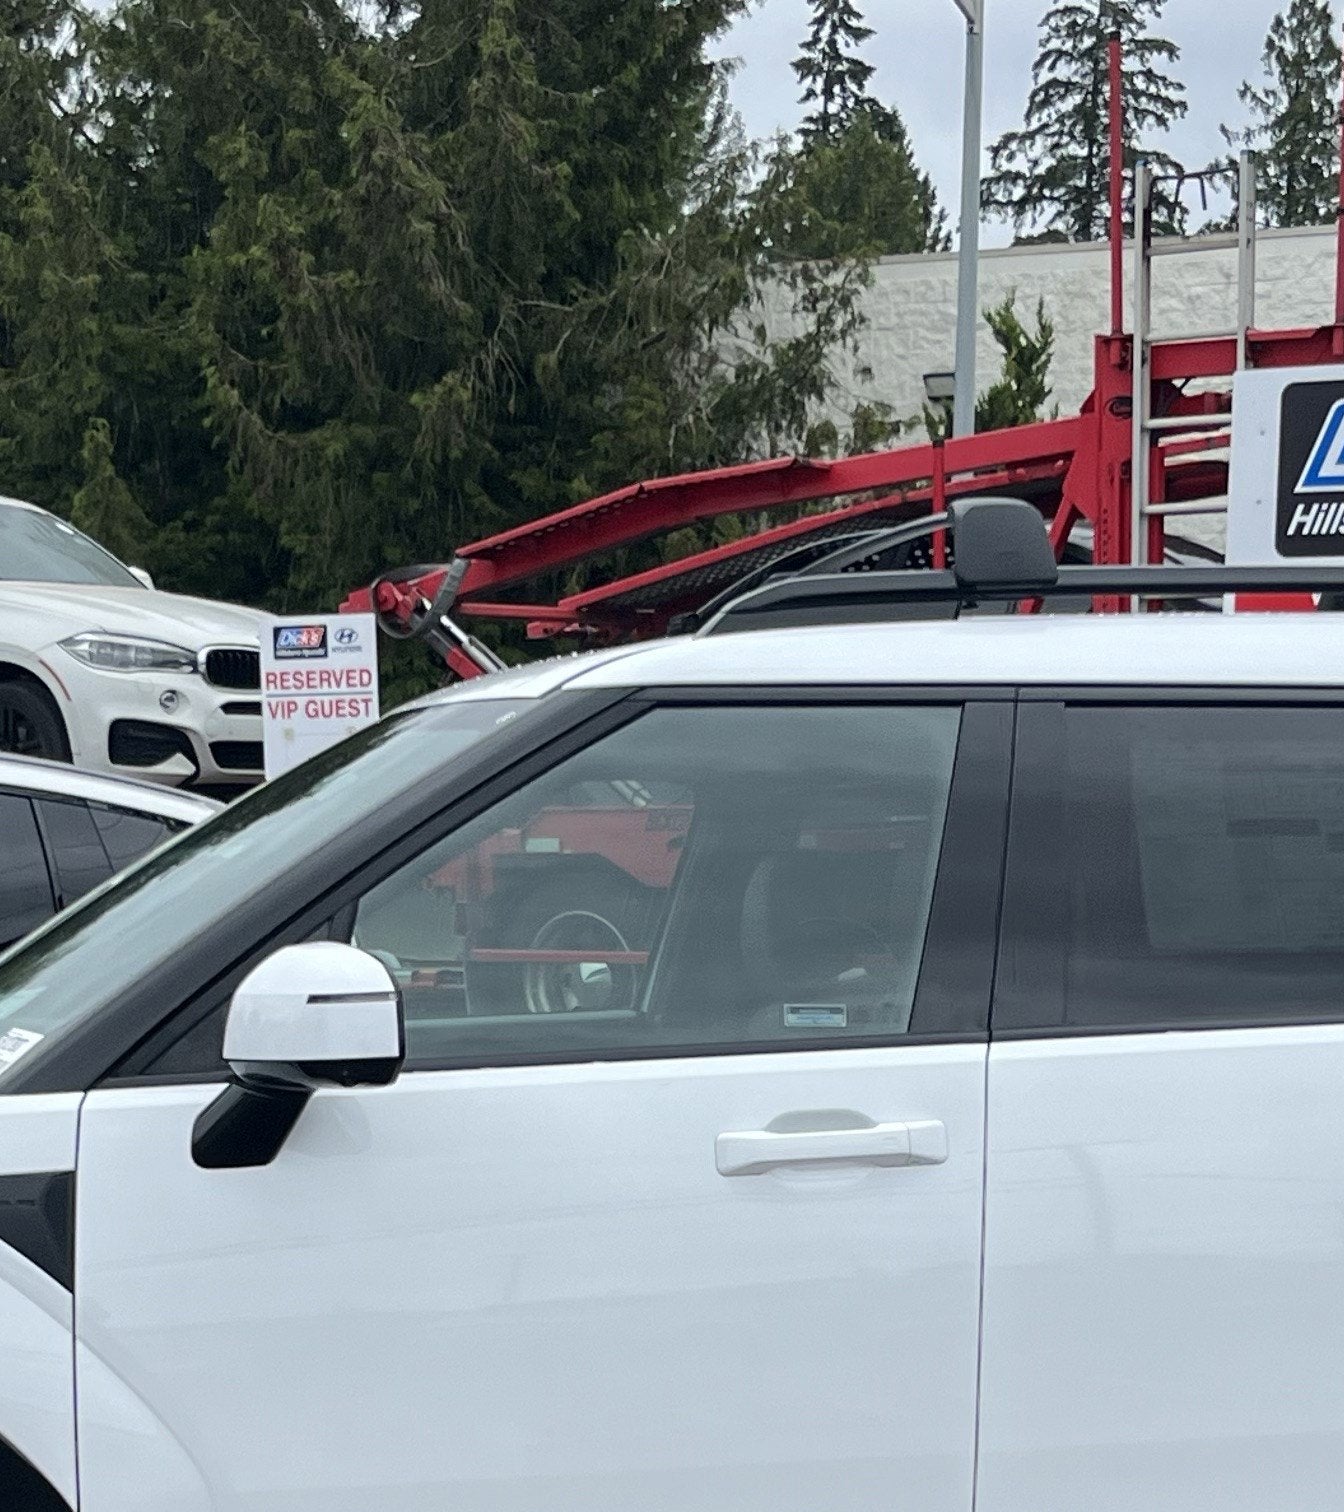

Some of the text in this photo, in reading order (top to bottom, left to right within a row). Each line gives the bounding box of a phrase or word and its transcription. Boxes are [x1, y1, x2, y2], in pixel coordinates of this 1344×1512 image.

[265, 668, 372, 690] RESERVED
[267, 698, 373, 720] VIP GUEST
